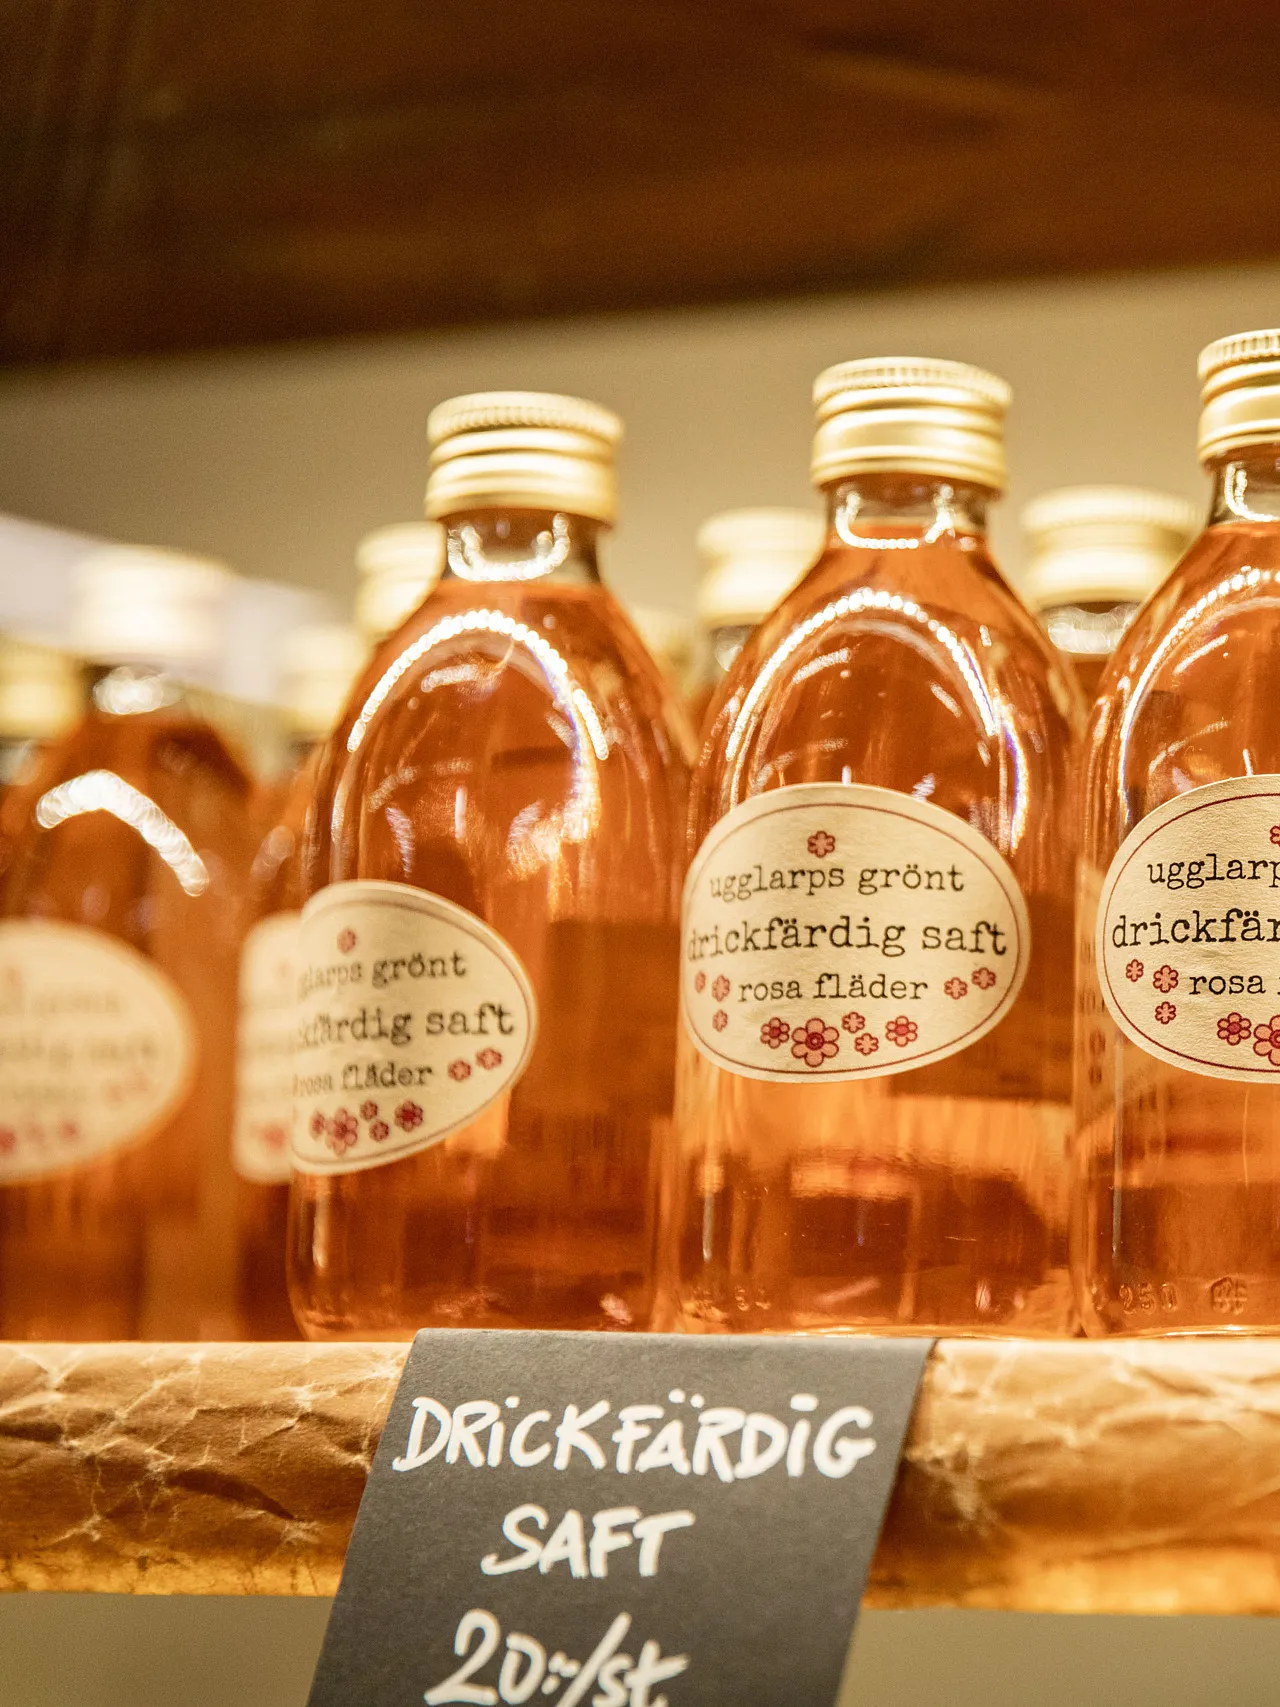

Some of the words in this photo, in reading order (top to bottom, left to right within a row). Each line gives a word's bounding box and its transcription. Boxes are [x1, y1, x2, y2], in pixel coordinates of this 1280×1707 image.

[710, 864, 845, 902] ugglarps
[858, 863, 965, 895] grönt
[687, 915, 906, 963] drickfärdig
[922, 920, 1007, 956] saft
[372, 952, 468, 989] grönt
[738, 980, 803, 1003] rosa
[811, 973, 929, 1000] fläder
[1188, 974, 1265, 996] rosa
[426, 1001, 515, 1036] saft
[341, 1062, 434, 1091] fläder
[480, 1503, 696, 1579] SAFT
